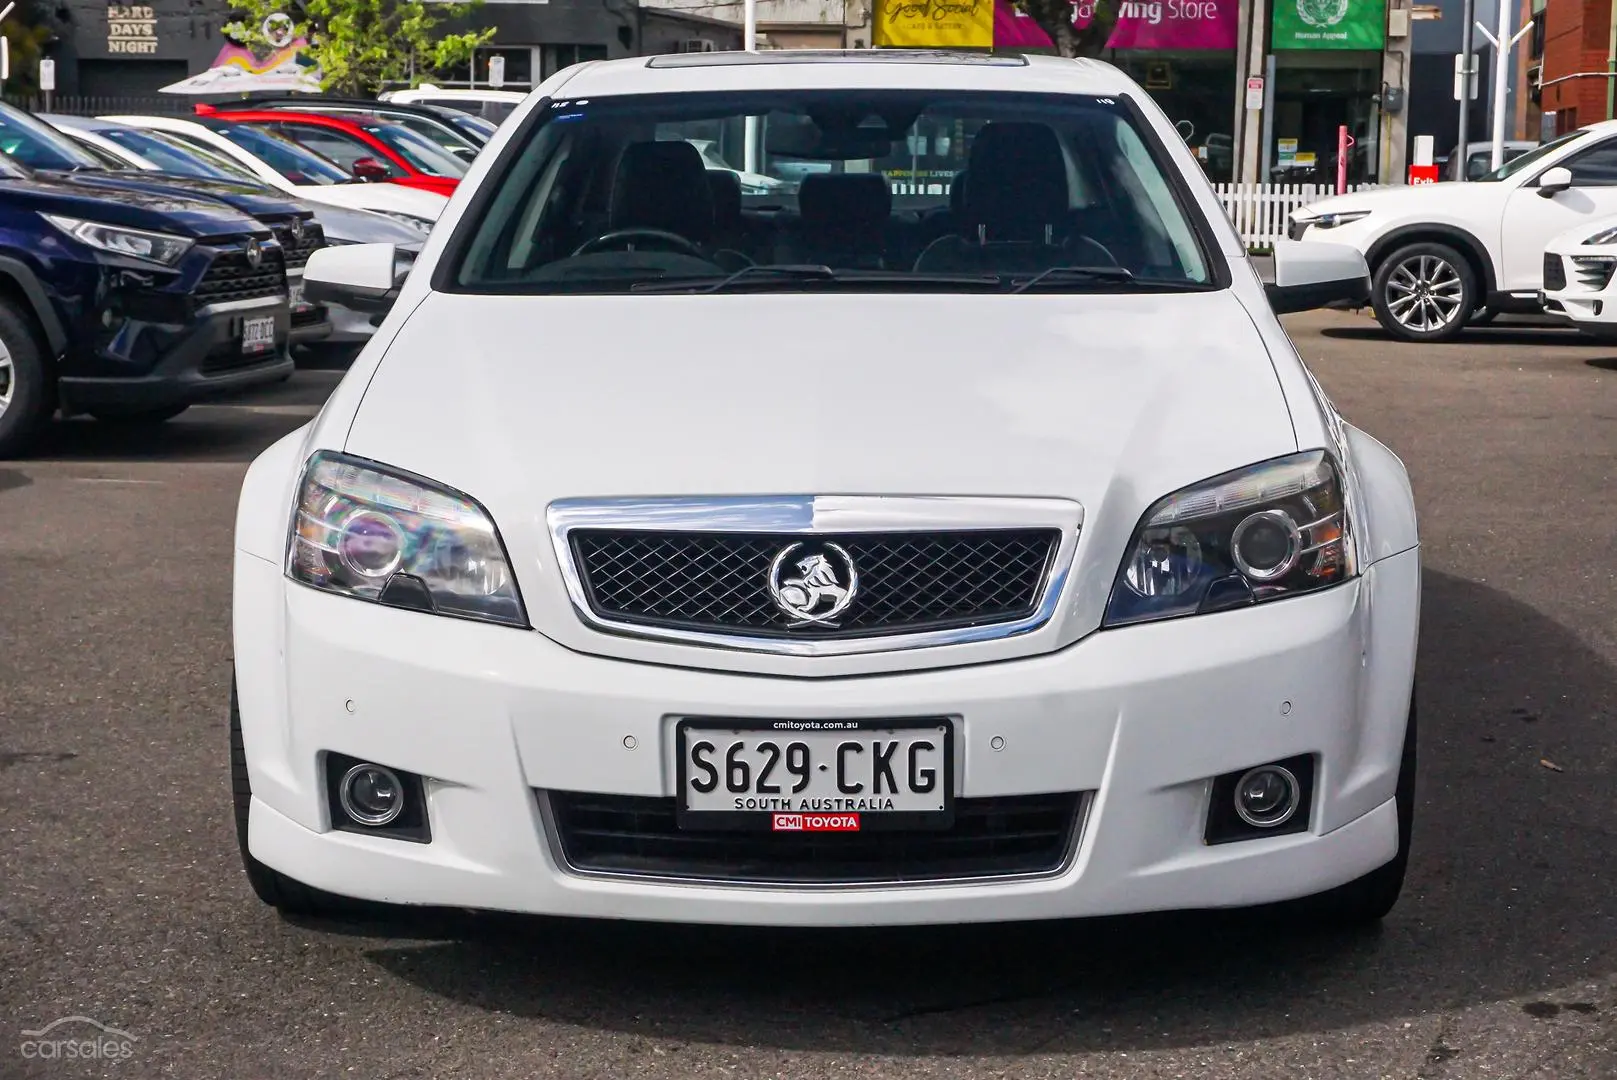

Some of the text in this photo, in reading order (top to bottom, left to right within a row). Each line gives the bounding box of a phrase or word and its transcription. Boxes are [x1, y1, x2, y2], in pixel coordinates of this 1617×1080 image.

[107, 6, 154, 18] HARD
[1167, 0, 1217, 20] Store
[110, 24, 153, 35] DAYS
[1322, 32, 1348, 40] Appeal
[107, 41, 158, 54] NIGHT
[773, 720, 859, 731] cmitoyota.com.au
[734, 797, 895, 810] SOUTH AUSTRALIA
[775, 815, 857, 829] CMI TOYOTA
